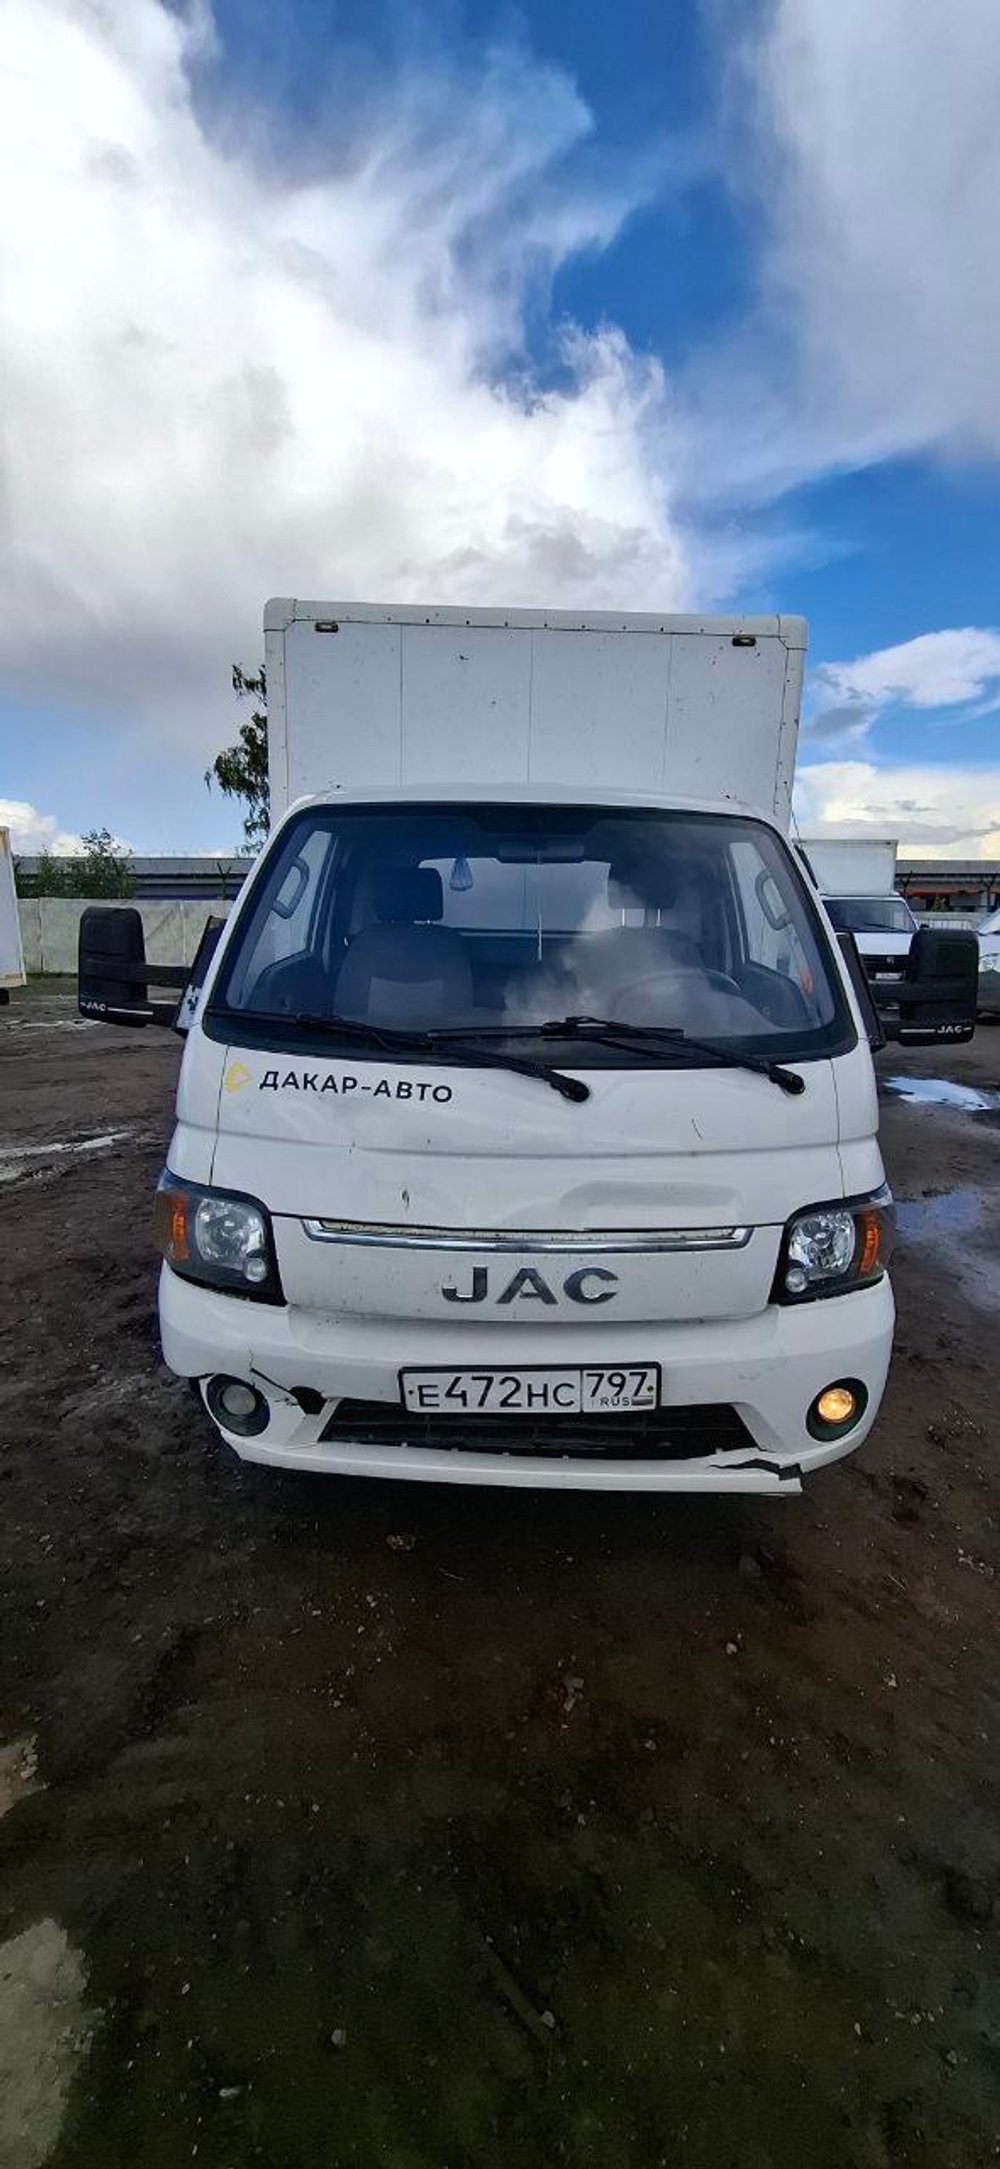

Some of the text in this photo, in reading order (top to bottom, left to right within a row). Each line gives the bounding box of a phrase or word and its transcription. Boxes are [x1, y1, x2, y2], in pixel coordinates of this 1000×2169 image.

[937, 1025, 962, 1033] JAC
[259, 1070, 453, 1103] ДАКАР-АВТО
[441, 1266, 619, 1305] JAC
[585, 1371, 648, 1398] 797
[600, 1396, 630, 1407] RUS
